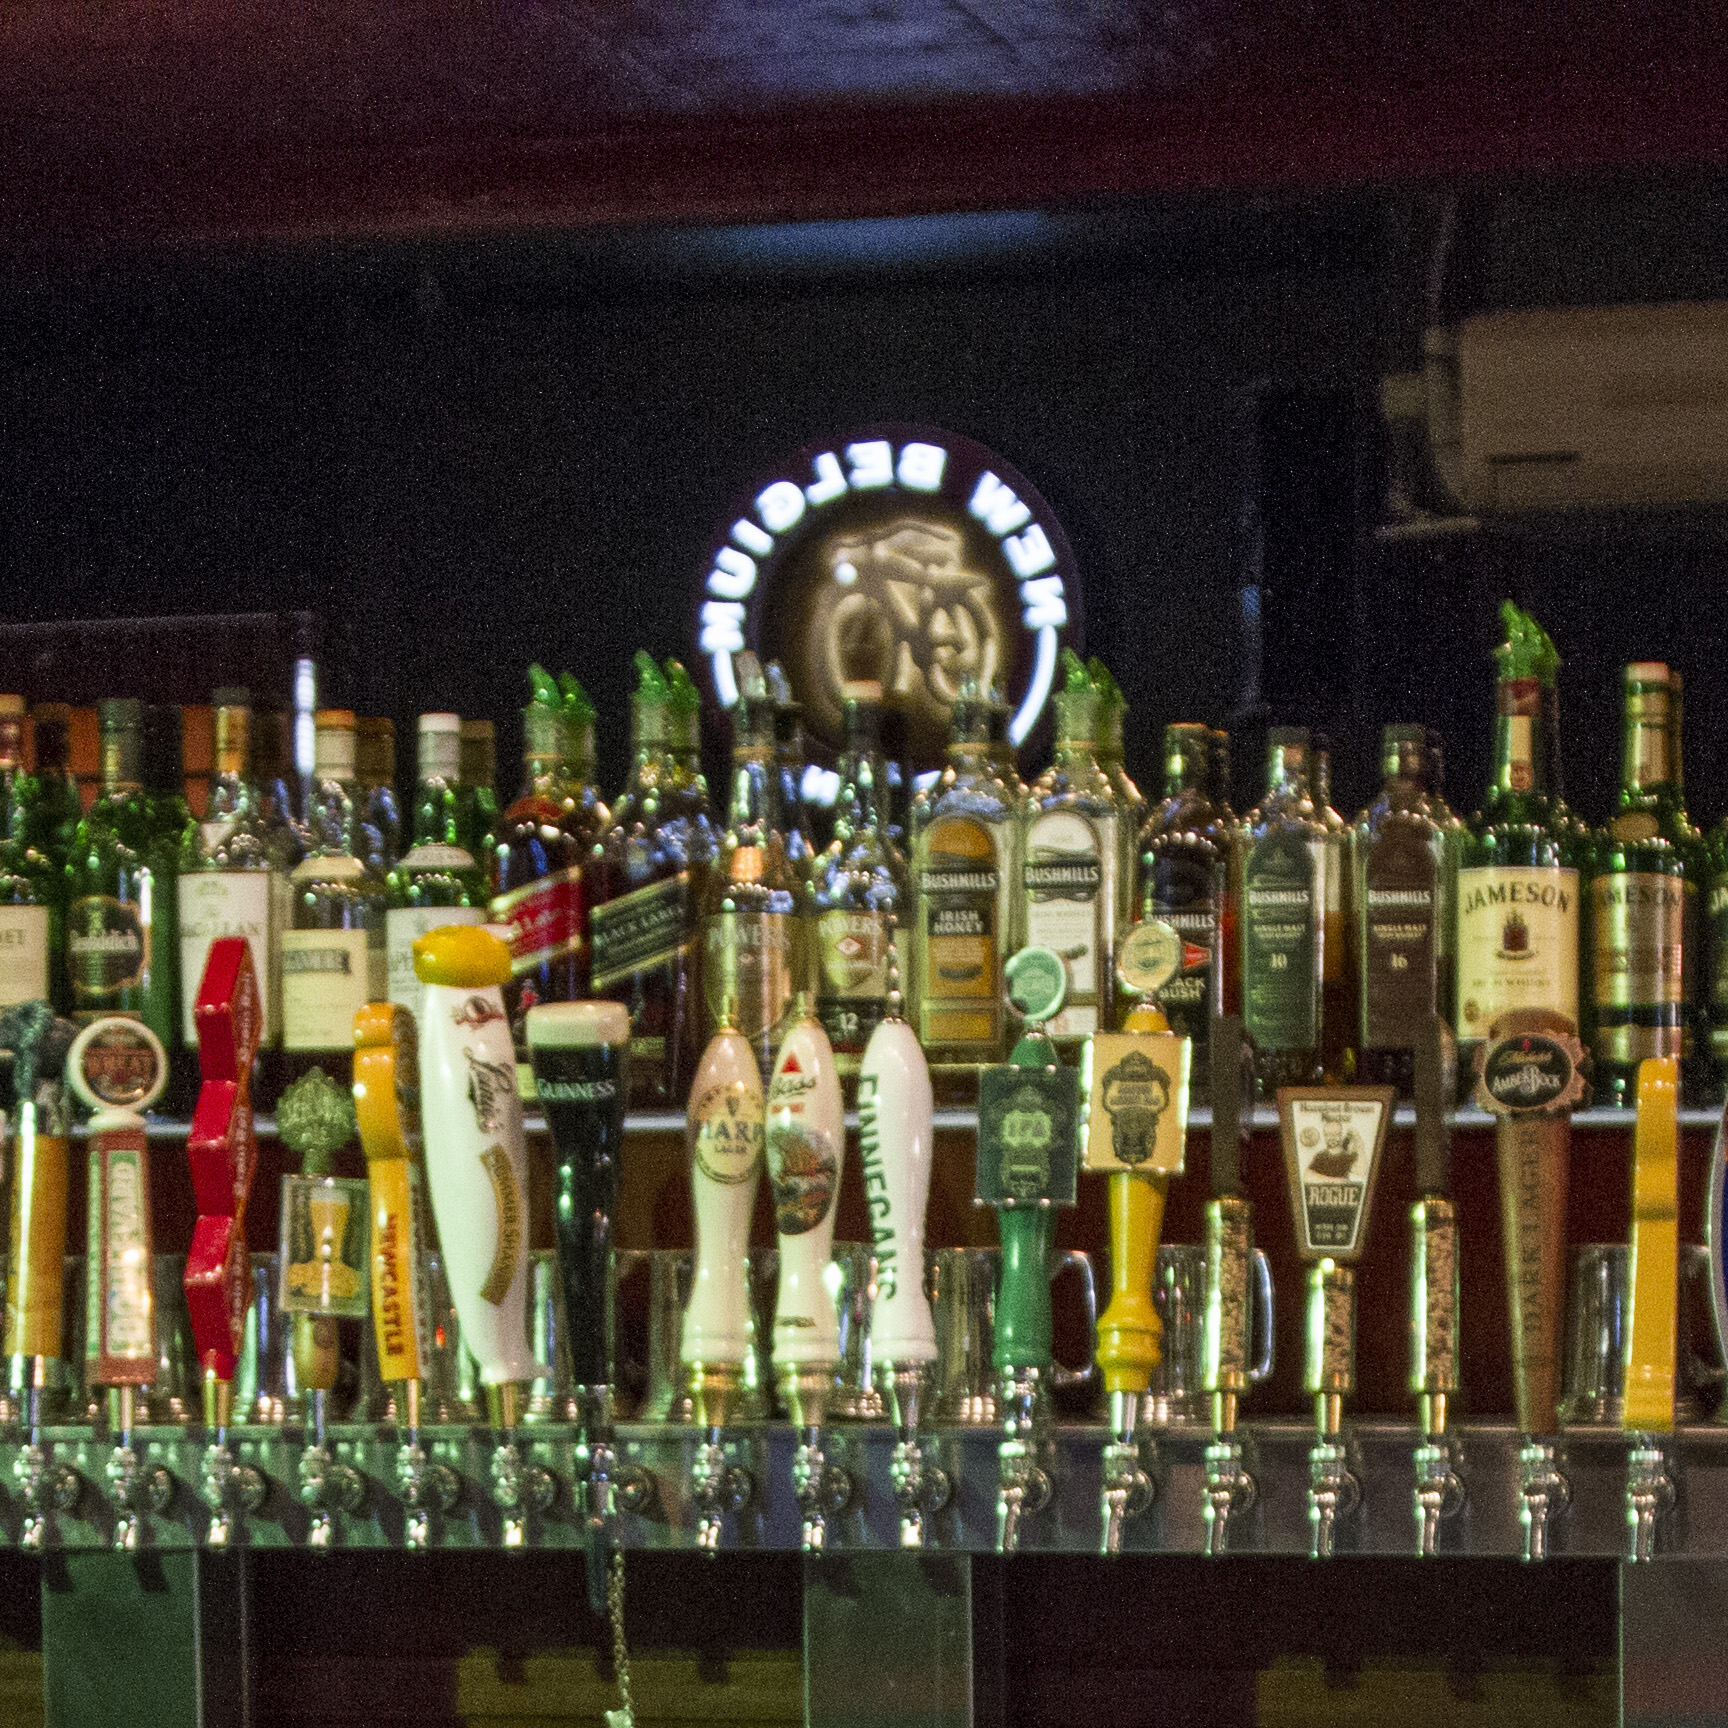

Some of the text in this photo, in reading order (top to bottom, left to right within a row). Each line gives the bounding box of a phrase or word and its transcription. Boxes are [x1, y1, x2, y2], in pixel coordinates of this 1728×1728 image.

[921, 872, 997, 889] BUSHMILLS
[1025, 866, 1099, 883] BUSHMILLS
[1248, 889, 1310, 905] BUSHMILLS
[1368, 889, 1432, 905] BUSHMILLS
[1464, 881, 1571, 915] JAMESON
[939, 909, 980, 921] IRISH
[1146, 914, 1216, 929] USHMILLS
[933, 919, 983, 934] HONEY
[1269, 952, 1288, 969] 10
[1391, 952, 1409, 970] 16
[839, 1012, 859, 1031] 12
[536, 1077, 615, 1099] GUINNESS
[699, 1119, 764, 1143] HARP
[1007, 1120, 1048, 1138] IPA
[856, 1073, 897, 1303] FINNEGANS
[1308, 1186, 1360, 1206] ROGUE
[381, 1213, 404, 1356] NEWCASTLE
